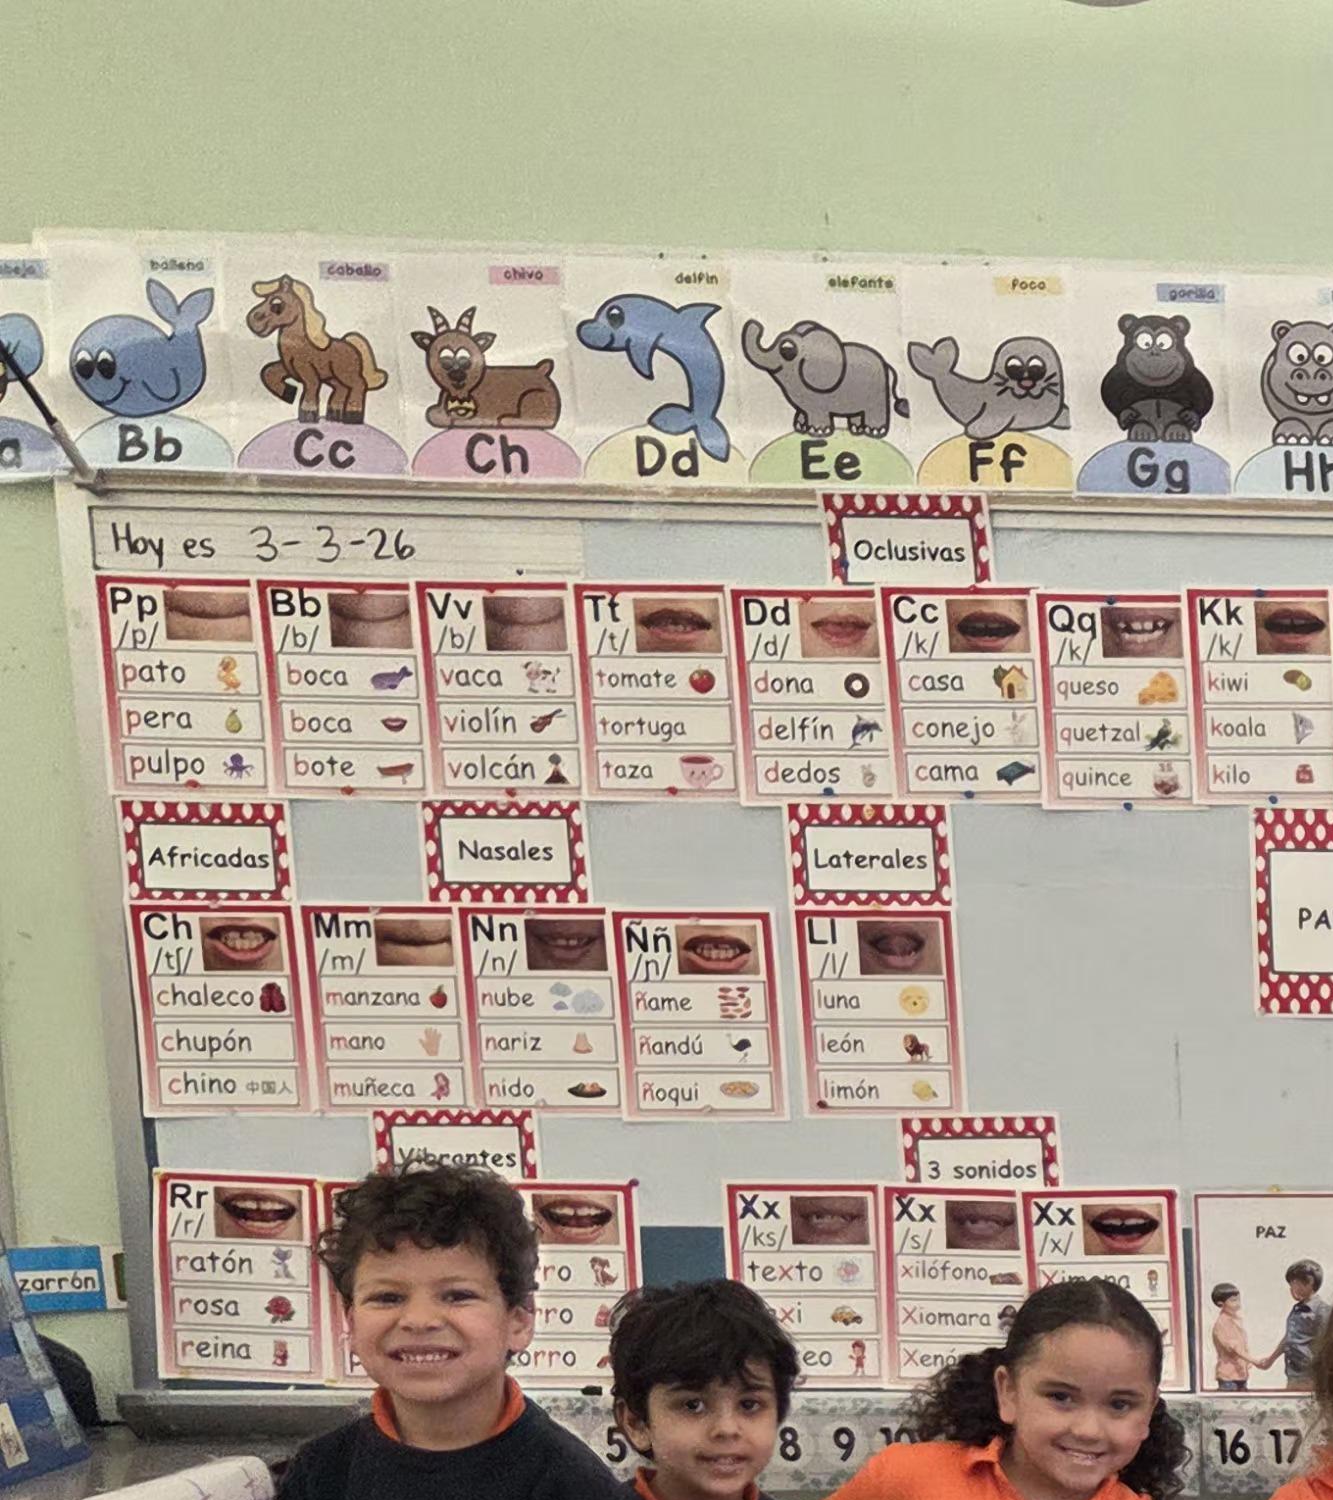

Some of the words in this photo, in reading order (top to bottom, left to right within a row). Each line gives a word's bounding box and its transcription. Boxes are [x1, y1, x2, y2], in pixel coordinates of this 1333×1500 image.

[328, 263, 381, 278] caballo
[118, 425, 182, 463] Bb
[466, 432, 529, 475] Ch
[801, 441, 861, 482] Ee
[969, 443, 1027, 483] Ff
[112, 522, 163, 570] Hoy
[184, 536, 215, 558] es
[854, 539, 965, 563] Oclusivas
[110, 587, 158, 619] Pp
[893, 595, 939, 623] Cc
[122, 659, 186, 690] pato
[287, 663, 347, 687] boca
[596, 670, 676, 690] tomate
[755, 671, 814, 695] dona
[908, 673, 964, 691] casa
[1208, 671, 1248, 692] kiwi
[1057, 677, 1119, 697] queso
[126, 709, 192, 739] pera
[444, 708, 516, 734] violín
[600, 718, 686, 742] tortuga
[759, 715, 833, 742] delfín
[912, 717, 994, 746] conejo
[1211, 717, 1266, 738] koala
[1061, 721, 1140, 746] quetzal
[130, 749, 204, 783] pulpo
[448, 753, 534, 780] volcán
[603, 760, 653, 780] taza
[148, 844, 270, 869] Africadas
[459, 839, 553, 862] Nasales
[814, 848, 928, 870] Laterales
[314, 913, 371, 939] Mm
[157, 983, 254, 1007] chaleco
[481, 987, 534, 1007] nube
[636, 991, 692, 1012] ñame
[817, 989, 860, 1009] luna
[162, 1028, 251, 1058] chupón
[485, 1033, 542, 1051] nariz
[639, 1033, 702, 1055] ñandú
[821, 1032, 864, 1053] león
[169, 1074, 236, 1095] chino
[333, 1076, 415, 1098] muñeca
[642, 1079, 698, 1107] ñoqui
[928, 1161, 940, 1180] 3
[953, 1160, 1036, 1181] sonidos
[739, 1194, 780, 1220] Xx
[1256, 1225, 1286, 1239] PAZ
[176, 1249, 252, 1274] ratón
[748, 1262, 823, 1282] texto
[901, 1257, 989, 1281] xilófono
[902, 1306, 991, 1327] Xiomara
[181, 1338, 251, 1360] reina
[779, 1427, 801, 1461] 8
[833, 1427, 856, 1461] 9
[1214, 1429, 1250, 1464] 16
